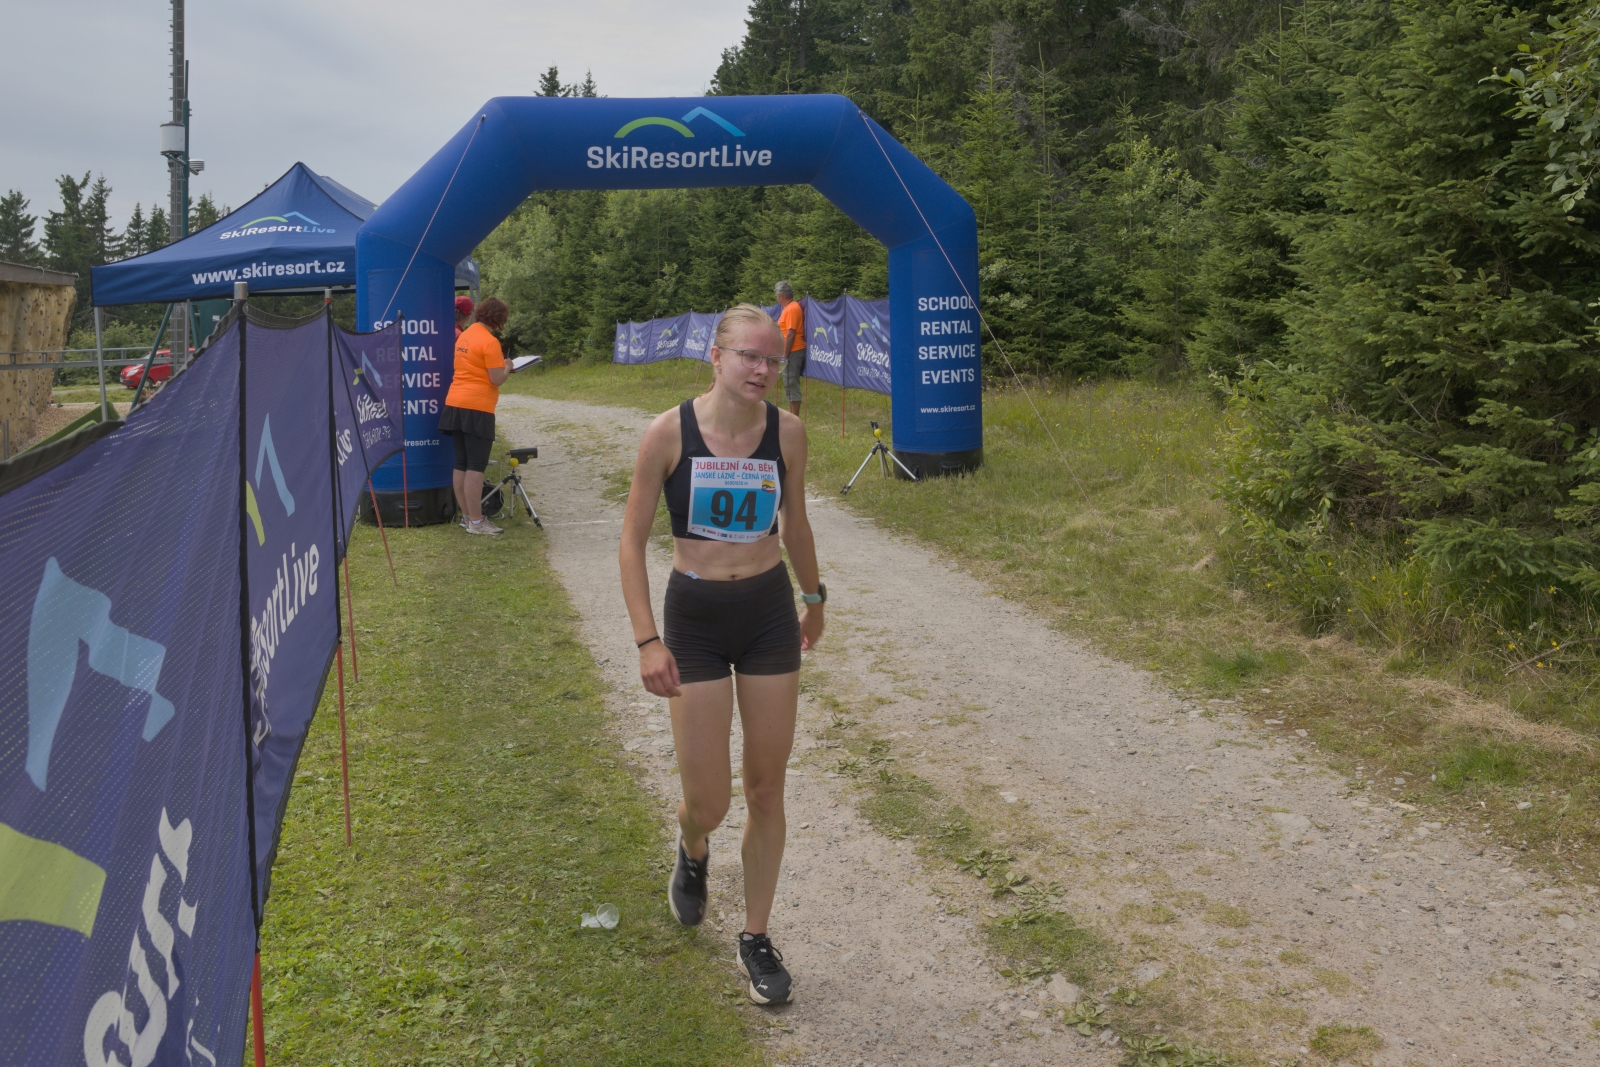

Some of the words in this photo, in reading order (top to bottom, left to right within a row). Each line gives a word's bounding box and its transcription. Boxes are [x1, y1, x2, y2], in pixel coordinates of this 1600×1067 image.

[587, 144, 772, 169] SkiResortLive
[220, 225, 336, 240] SkiResortLive
[192, 260, 345, 285] www.skiresort.cz
[918, 296, 974, 311] SCHOOL
[920, 320, 973, 335] RENTAL
[918, 344, 976, 360] SERVICE
[921, 368, 974, 385] EVENTS
[920, 405, 976, 413] www.skiresort.cz
[695, 461, 739, 471] JUBILEJNÍ
[742, 463, 756, 471] 40.
[758, 462, 774, 472] BĚH
[695, 471, 716, 479] JANSKÉ
[717, 471, 735, 480] LÁZNĚ
[742, 472, 759, 480] ČERNÁ
[710, 490, 757, 530] 94
